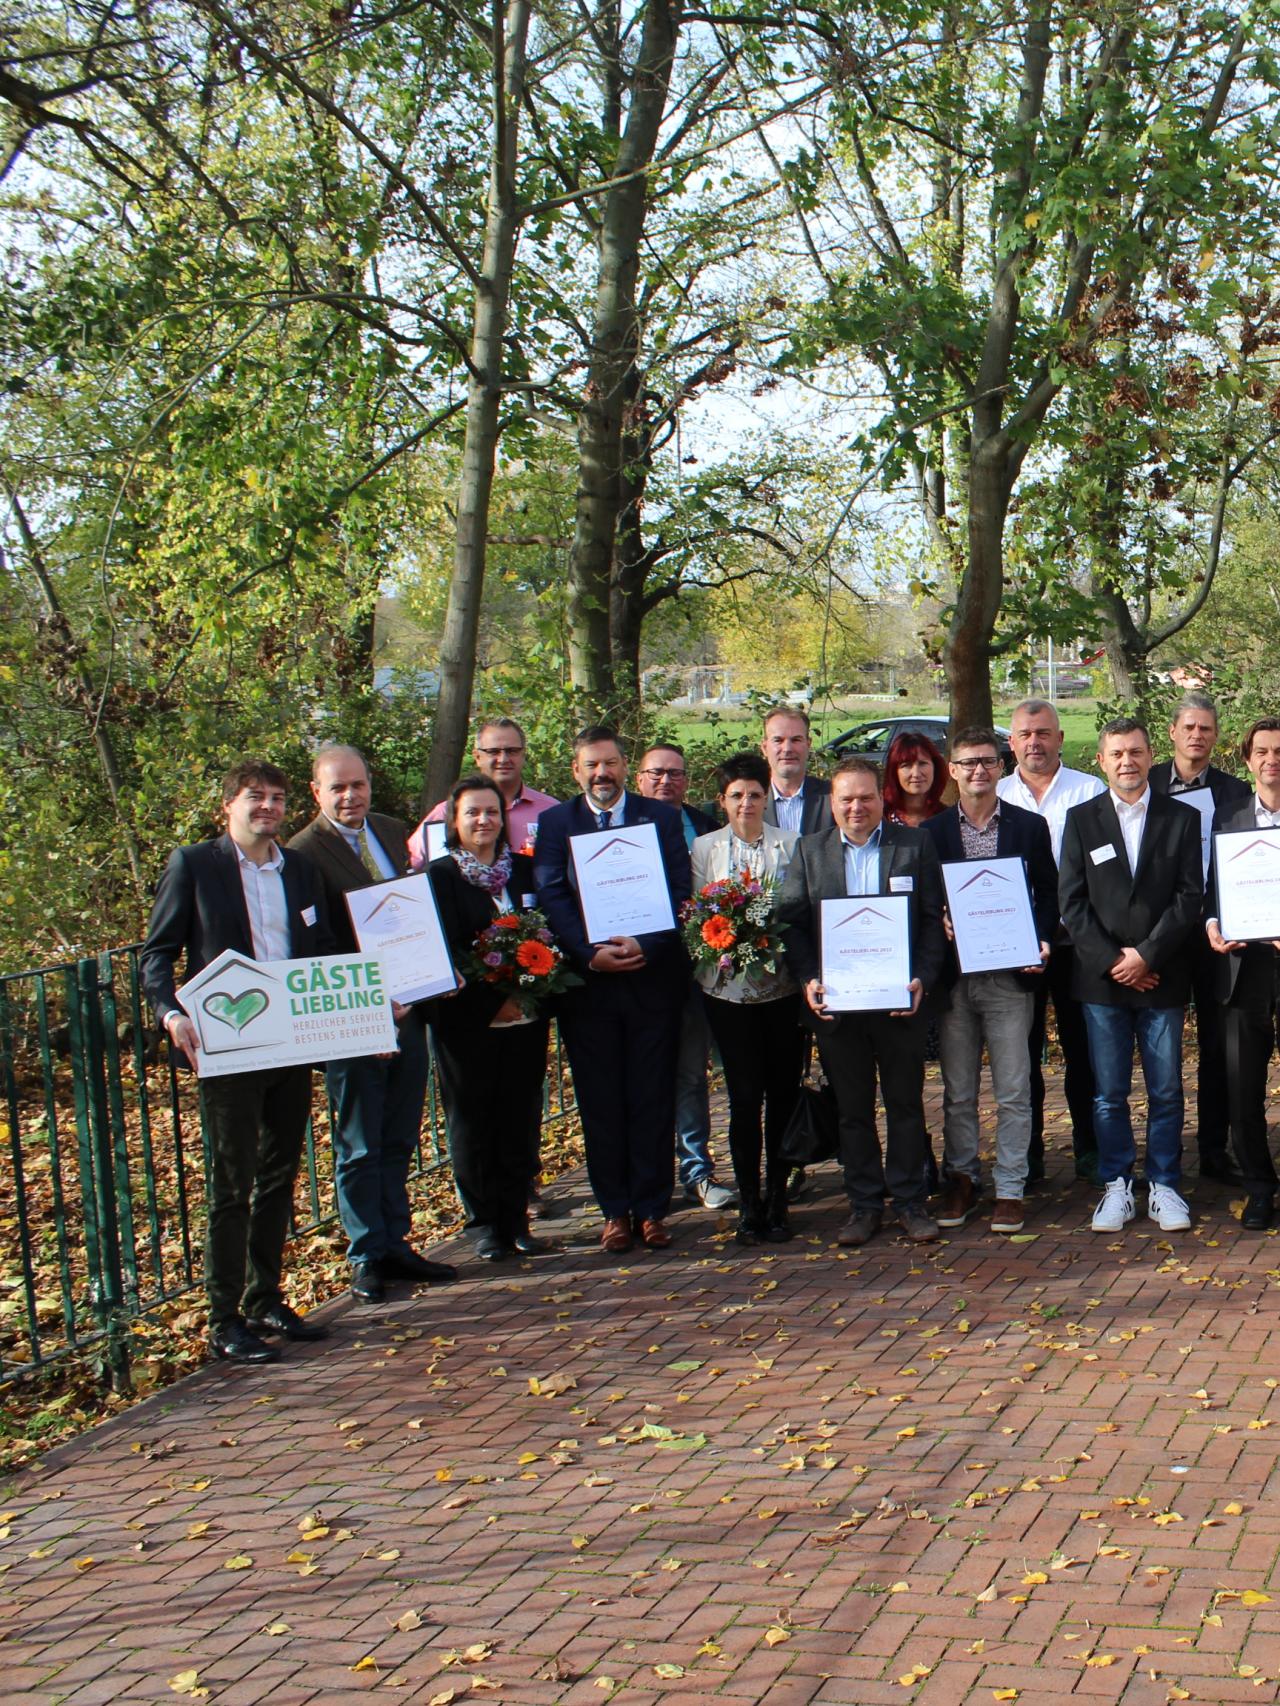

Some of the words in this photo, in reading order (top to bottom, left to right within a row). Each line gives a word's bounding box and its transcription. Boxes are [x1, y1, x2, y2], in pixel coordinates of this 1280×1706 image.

[287, 961, 382, 994] GÄSTE
[290, 988, 385, 1016] LIEBLING
[293, 1016, 346, 1031] HERZLICHER
[295, 1031, 336, 1044] BESTENS
[340, 1024, 390, 1038] BEWERTET.
